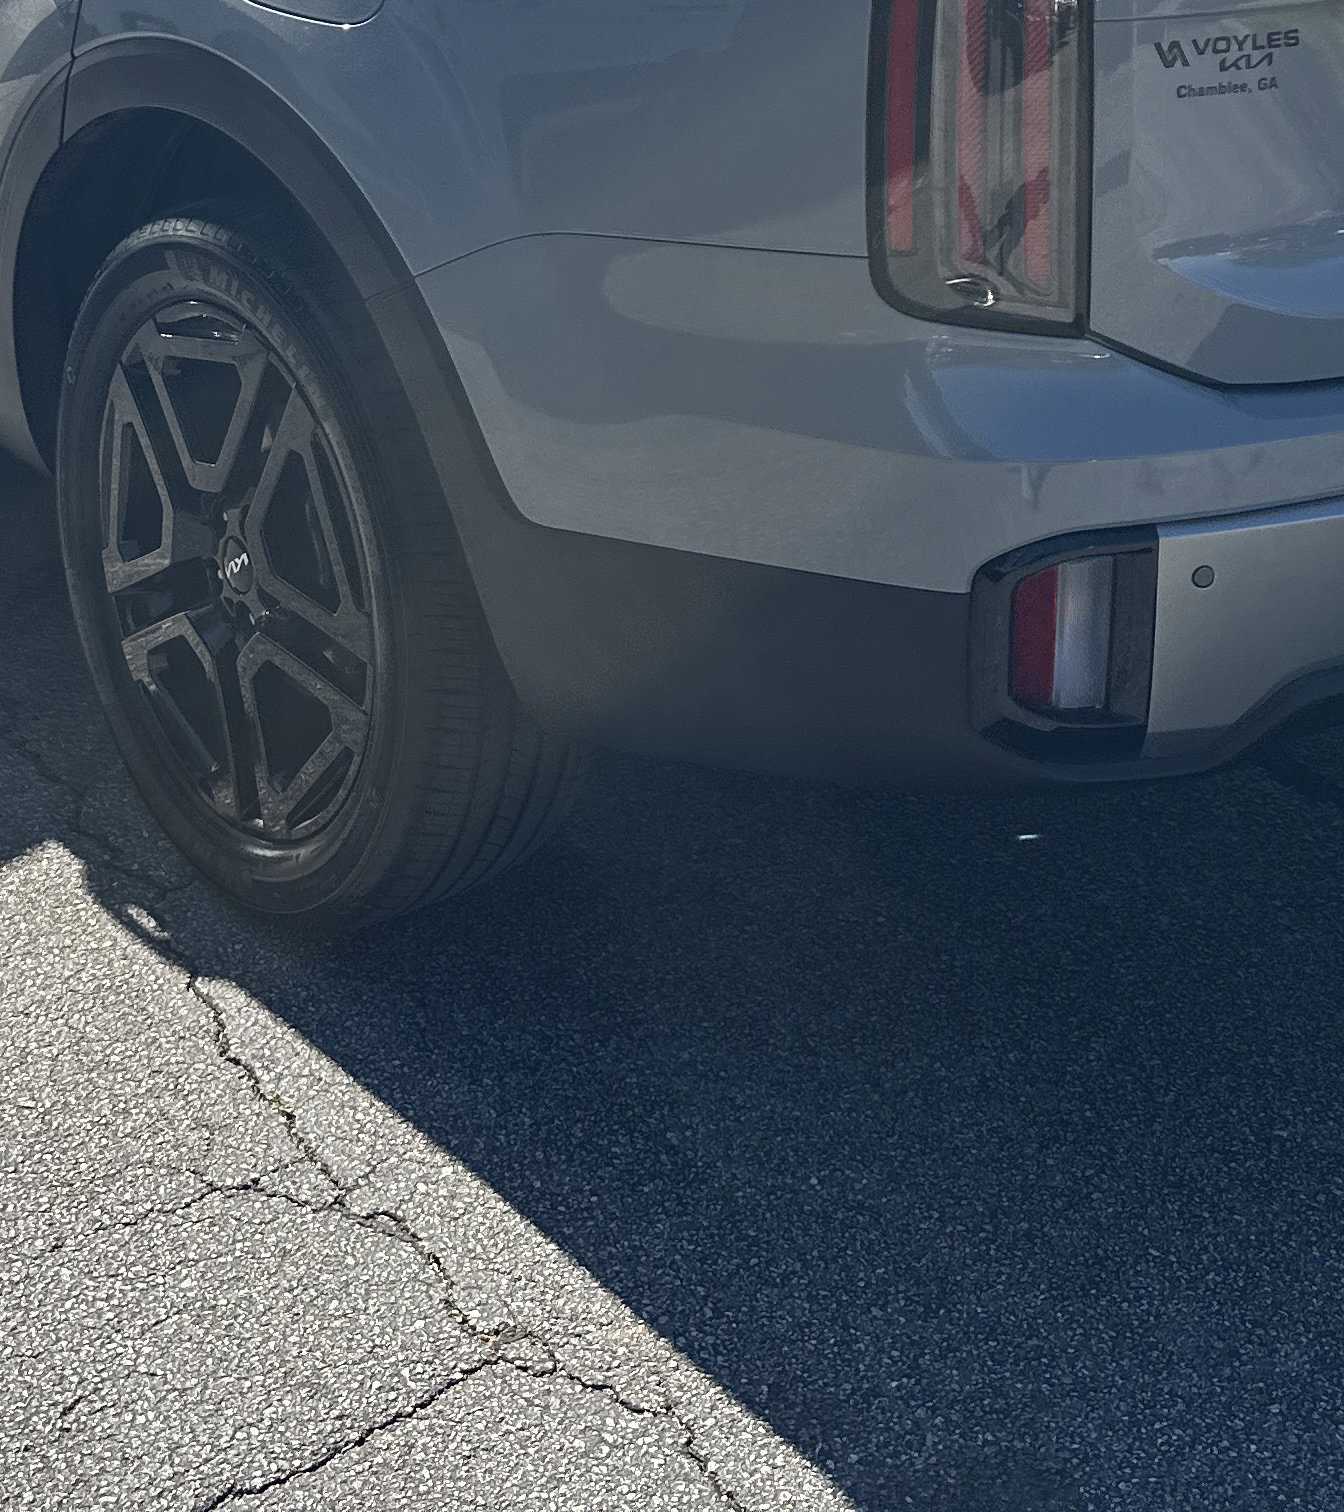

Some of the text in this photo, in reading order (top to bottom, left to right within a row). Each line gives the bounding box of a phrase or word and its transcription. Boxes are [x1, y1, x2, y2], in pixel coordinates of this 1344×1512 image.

[1191, 28, 1300, 56] VOYLES
[1176, 76, 1280, 99] Chamblee, GA
